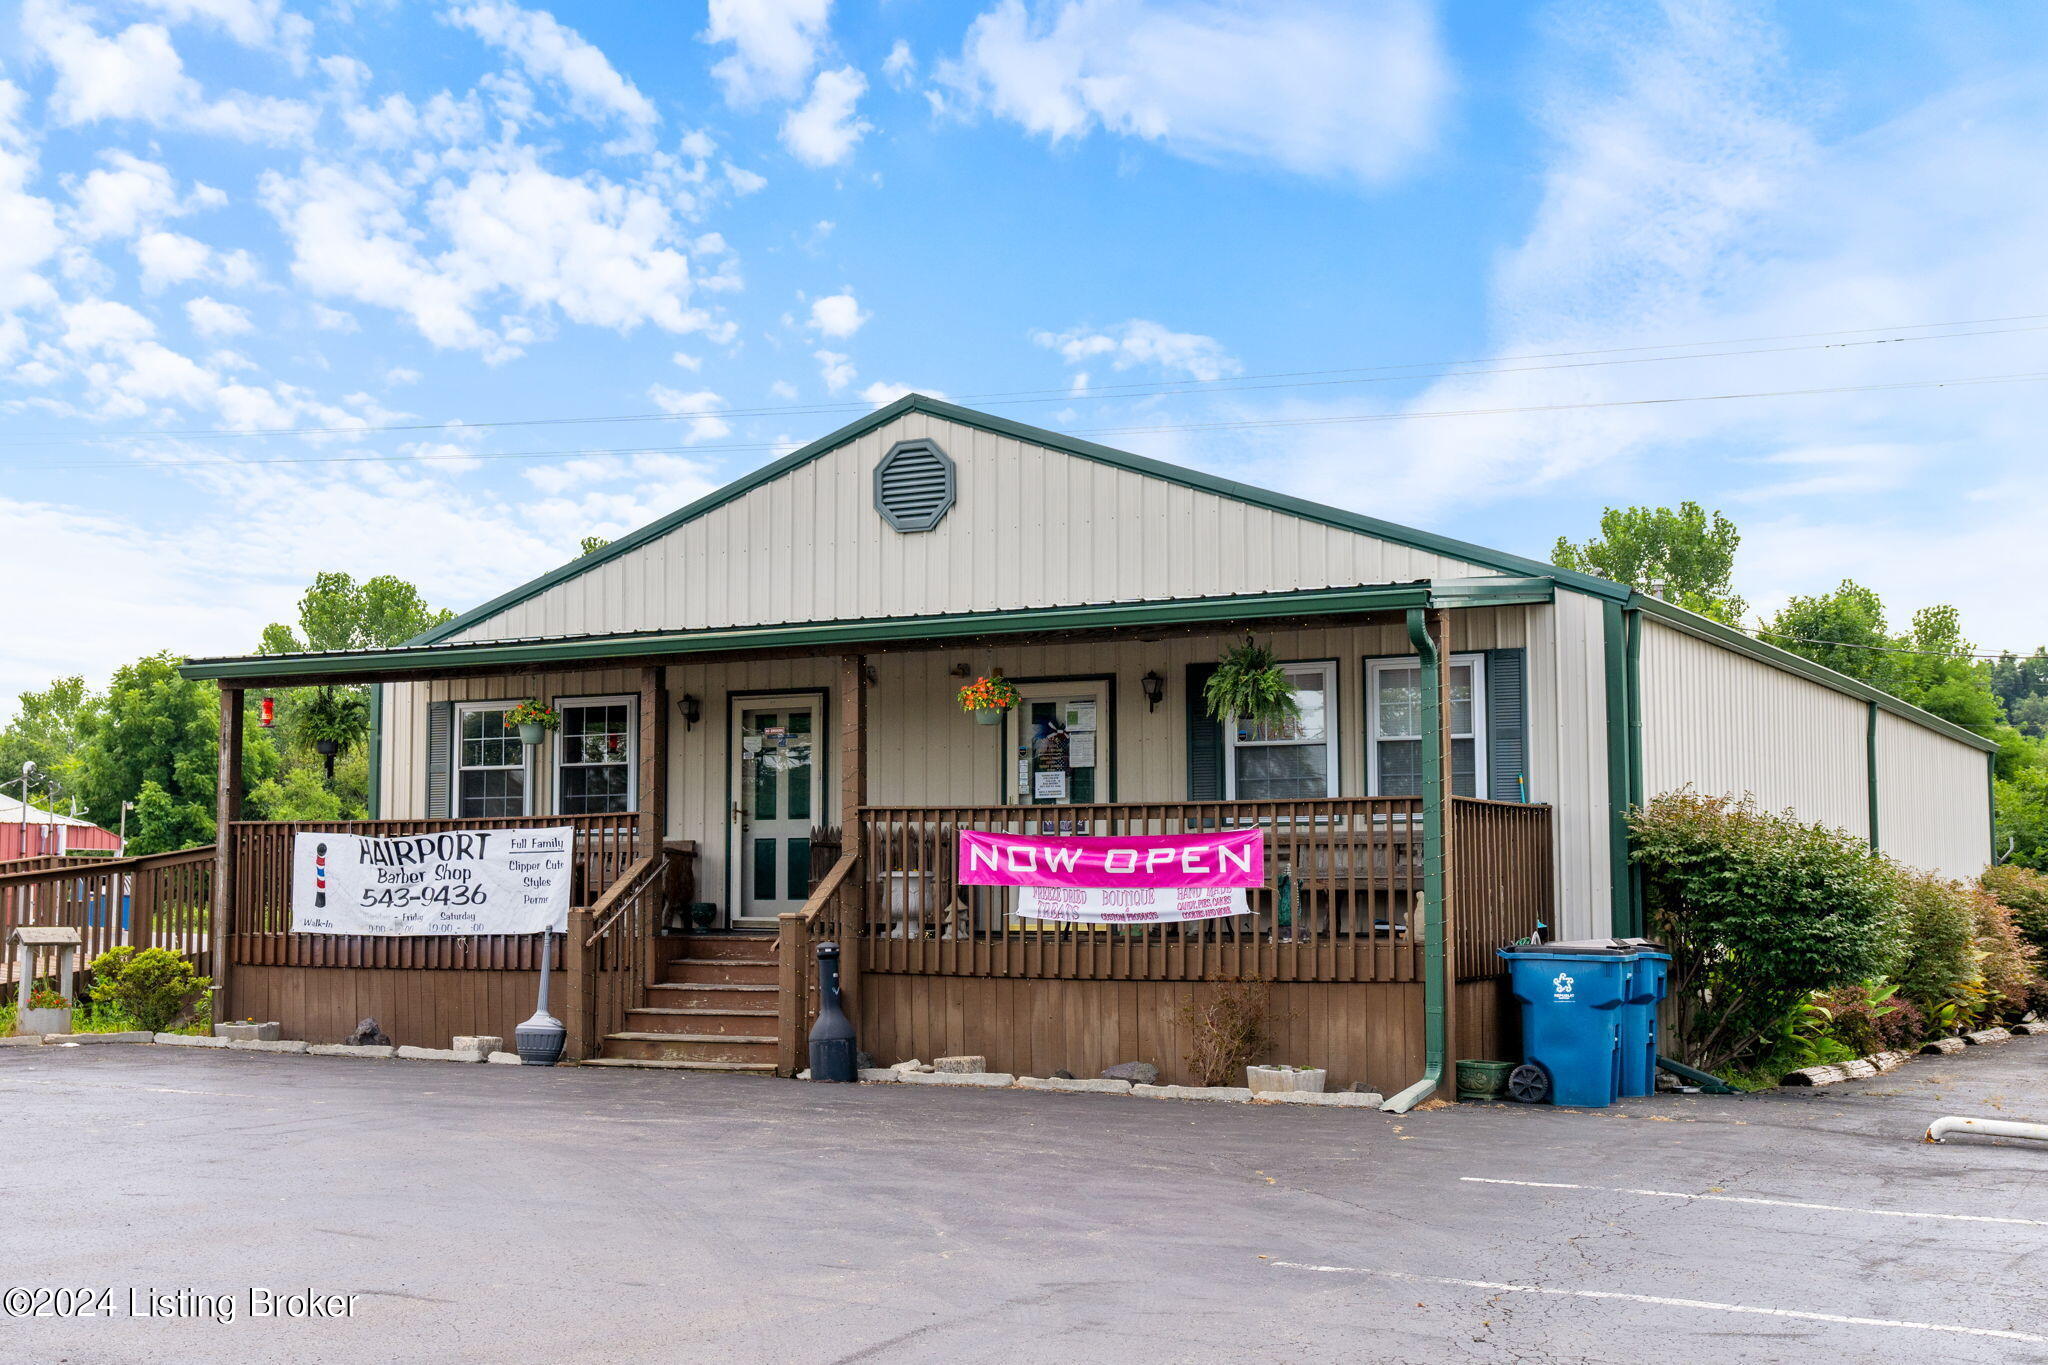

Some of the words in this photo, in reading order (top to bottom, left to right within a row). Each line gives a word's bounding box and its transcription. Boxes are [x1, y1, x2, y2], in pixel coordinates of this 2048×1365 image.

[358, 833, 492, 866] HAIRPORT
[511, 838, 527, 848] Full
[532, 837, 564, 850] Family
[970, 843, 1083, 873] NOW
[1104, 844, 1251, 873] OPEN
[509, 860, 541, 872] Clipper
[377, 867, 426, 883] Barber
[435, 863, 471, 884] Shop
[523, 876, 551, 889] Styles
[360, 883, 487, 907] 543-9436
[1033, 887, 1061, 901] FREEZE
[1062, 888, 1087, 905] DRIED
[1102, 888, 1155, 907] BOUTIQUE
[1177, 887, 1202, 900] HAND
[1212, 896, 1232, 907] CAKES
[440, 911, 476, 922] Saturday
[1037, 900, 1080, 920] TREATS
[303, 918, 333, 928] Walk-In
[402, 912, 424, 923] Friday
[1100, 912, 1125, 922] CUSTOM
[1127, 912, 1159, 921] PRODUCTS
